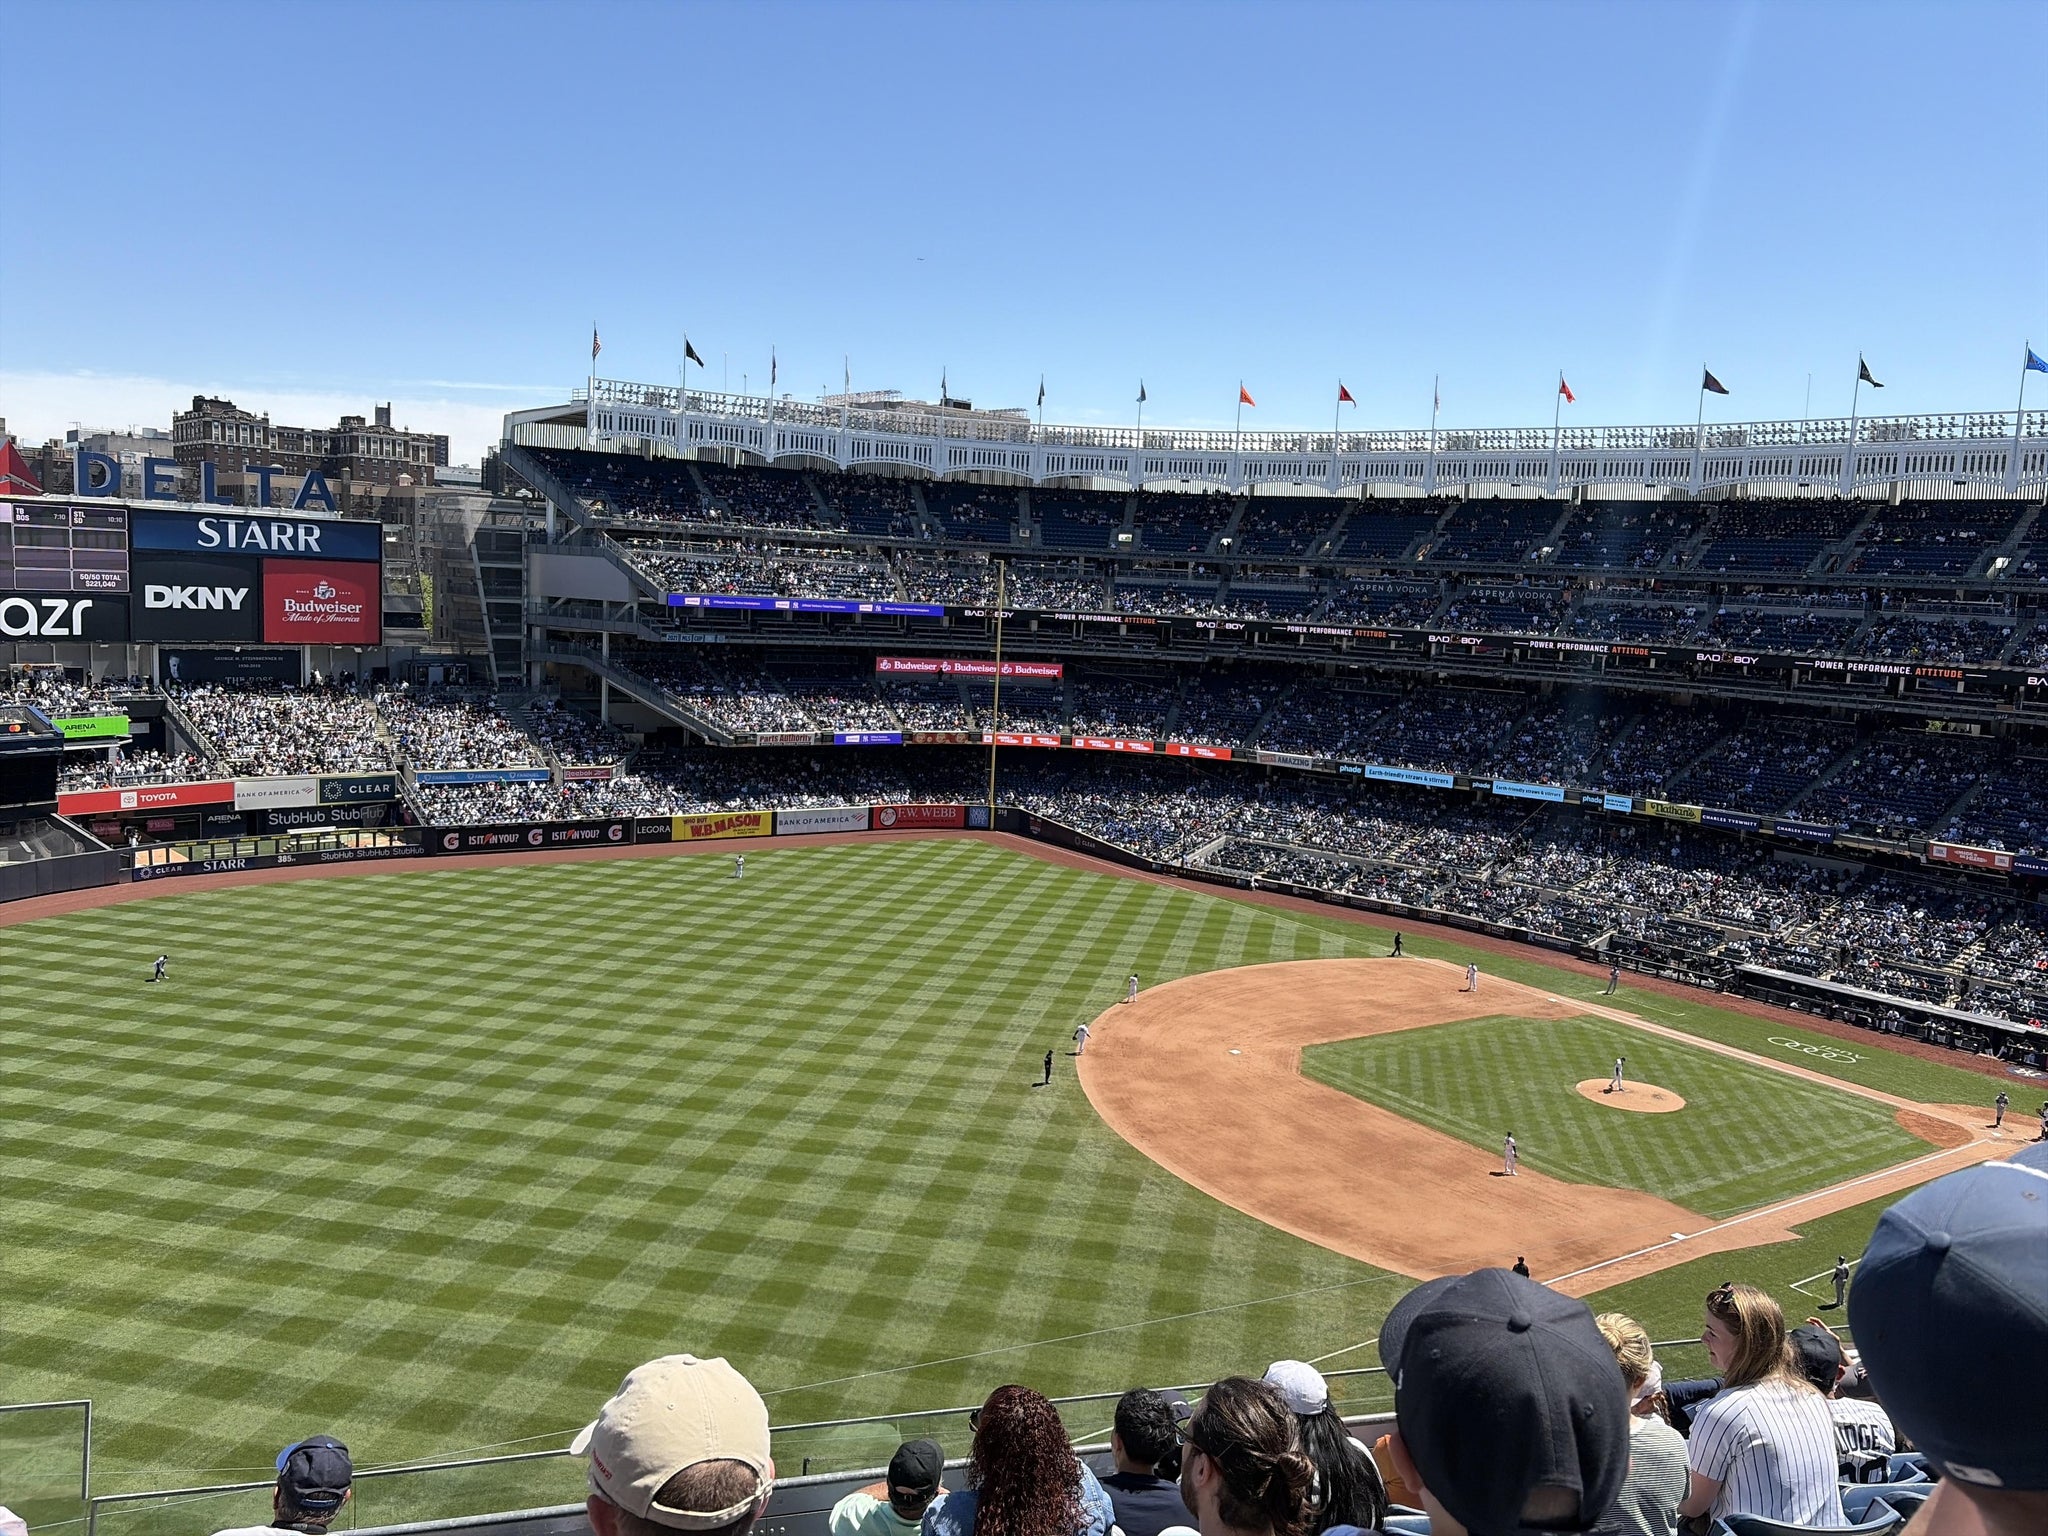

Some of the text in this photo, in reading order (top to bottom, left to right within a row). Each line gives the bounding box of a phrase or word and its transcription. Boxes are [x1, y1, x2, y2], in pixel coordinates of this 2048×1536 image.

[73, 449, 337, 512] DELTA
[198, 517, 321, 552] STARR
[1353, 584, 1428, 594] ASPEN VODKA
[145, 585, 248, 610] DKNY
[1519, 592, 1552, 600] VODKA
[284, 599, 362, 613] Budweiser
[0, 598, 92, 636] azr
[282, 613, 360, 623] Made of America
[1125, 616, 1156, 624] ATTITUDE
[1226, 622, 1245, 630] BOY
[1355, 630, 1386, 638] ATTITUDE
[1428, 635, 1483, 645] BAD BOY
[1612, 647, 1649, 656] ATTITUDE
[1696, 653, 1759, 665] BAD BOY
[894, 661, 937, 670] Budweiser
[1015, 666, 1058, 675] Budweiser
[1847, 663, 1912, 675] PERFORMANCE.
[1916, 667, 1963, 678] ATTITUDE
[760, 734, 812, 742] Parts Authority
[1277, 757, 1309, 767] AMAZING
[566, 770, 592, 778] Reebok
[1340, 766, 1362, 774] phade
[1369, 769, 1404, 779] Earth-friendly
[350, 785, 390, 794] CLEAR
[1472, 781, 1490, 790] phade
[140, 793, 177, 802] TOYOTA
[1583, 795, 1602, 803] phade
[331, 807, 384, 821] StubHub
[898, 808, 956, 818] F.W. WEBB
[1651, 803, 1696, 818] Nathan's
[207, 814, 241, 822] ARENA
[268, 811, 325, 825] StubHub
[1702, 814, 1757, 827] CHARLES TYRWHITT
[580, 830, 600, 838] YOU?
[637, 825, 671, 834] LEGORA
[1802, 829, 1831, 838] TYRWHITT
[498, 834, 519, 843] YOU?
[321, 852, 354, 860] StubHub
[357, 849, 390, 858] StubHub
[203, 859, 246, 871] STARR
[2014, 862, 2038, 870] CHARLES
[156, 866, 182, 874] CLEAR
